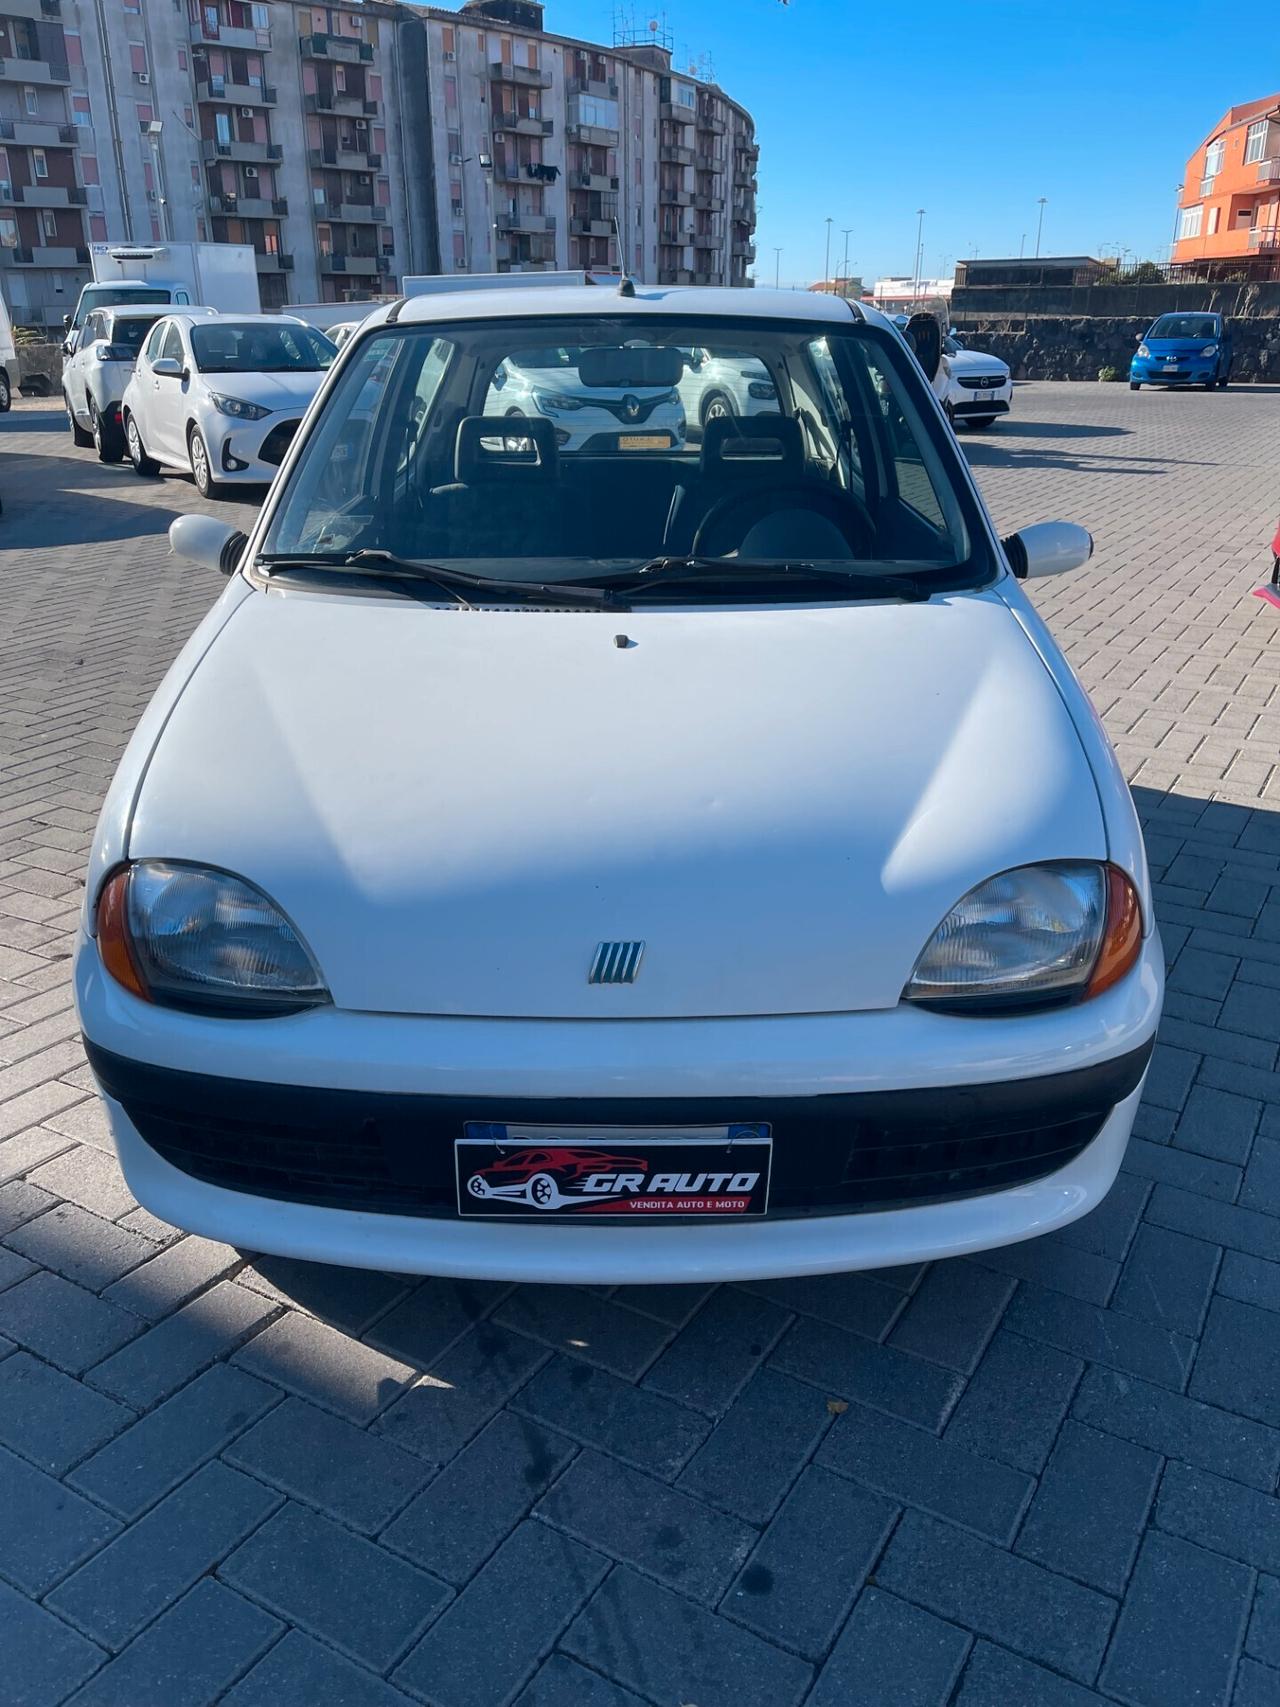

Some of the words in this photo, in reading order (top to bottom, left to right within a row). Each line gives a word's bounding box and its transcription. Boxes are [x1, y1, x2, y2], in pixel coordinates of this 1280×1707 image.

[583, 1173, 645, 1192] GR
[646, 1173, 760, 1192] AUTO
[630, 1201, 674, 1209] VENDITA
[677, 1201, 703, 1209] AUTO
[715, 1200, 745, 1208] MOTO
